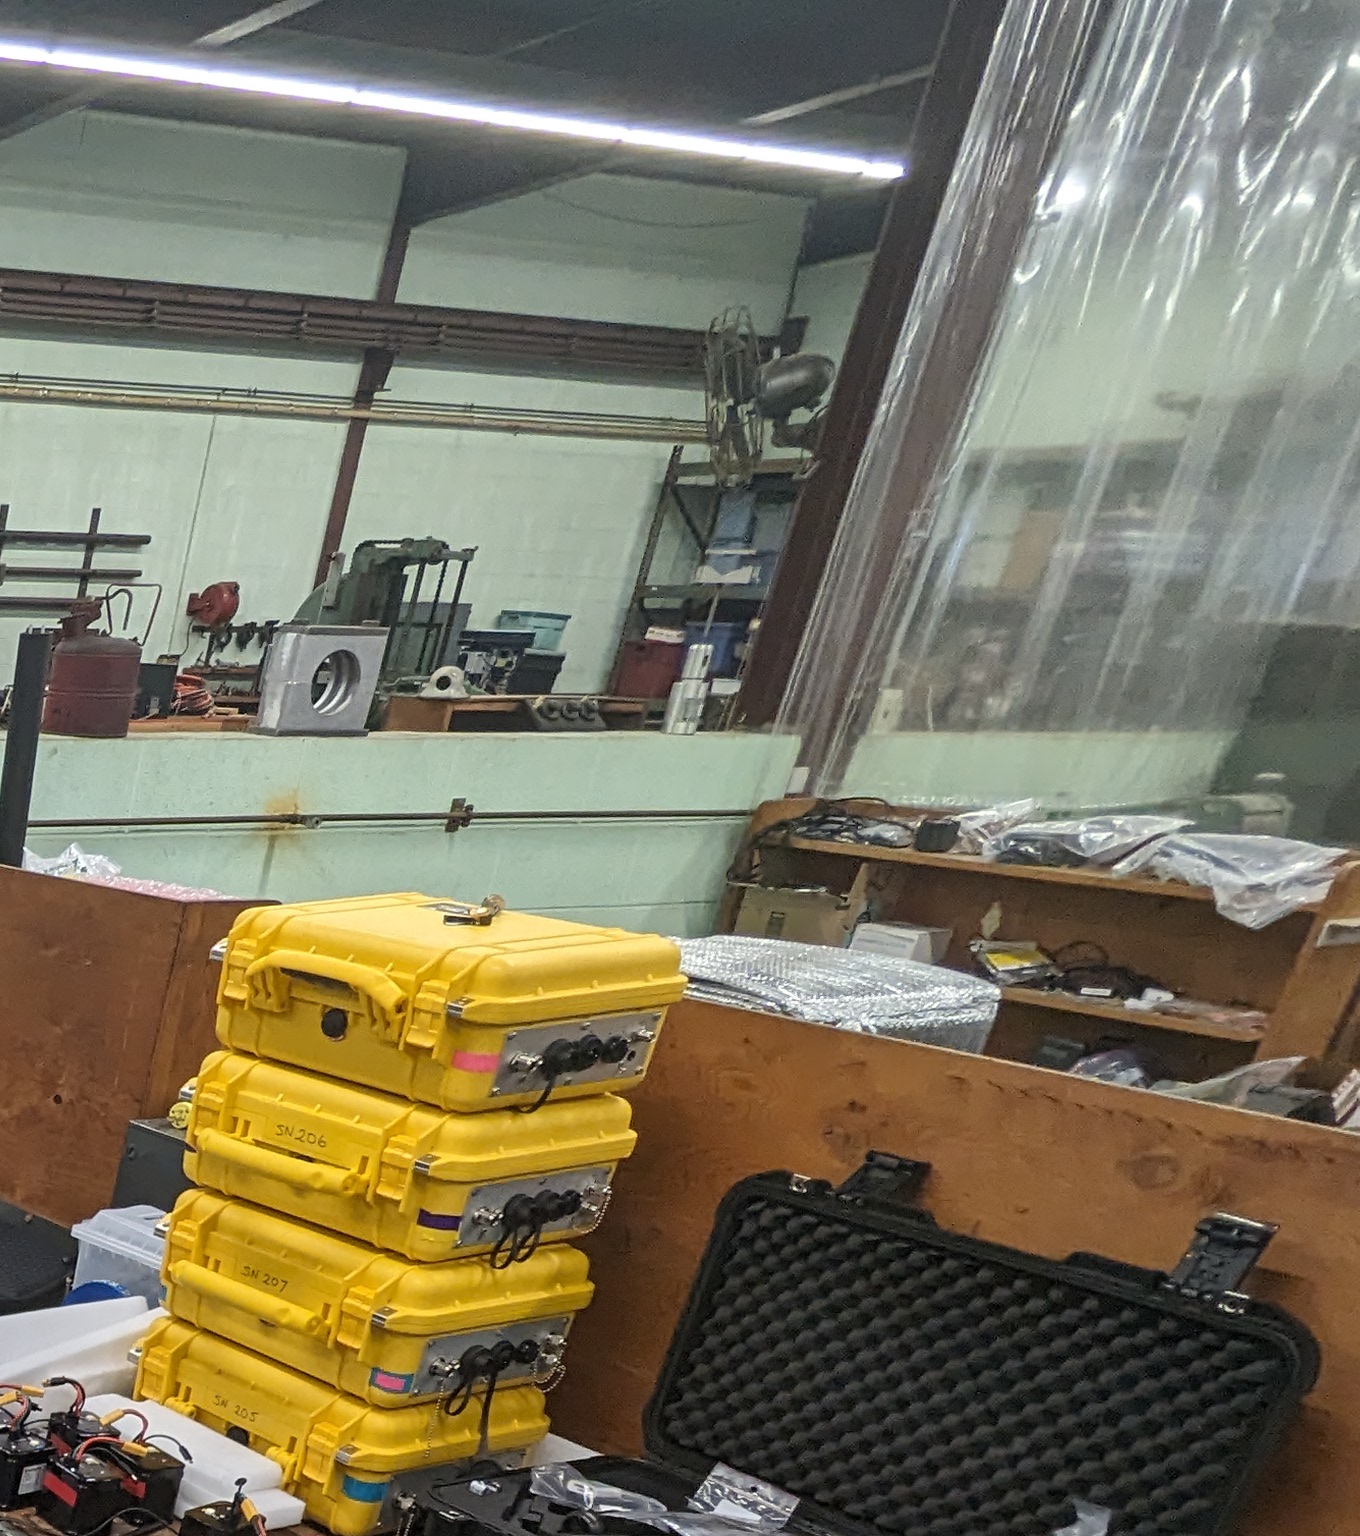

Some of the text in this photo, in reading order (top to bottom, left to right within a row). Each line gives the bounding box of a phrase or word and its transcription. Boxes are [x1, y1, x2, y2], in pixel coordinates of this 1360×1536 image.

[240, 1263, 290, 1294] SN 207
[213, 1392, 259, 1423] SN 205
